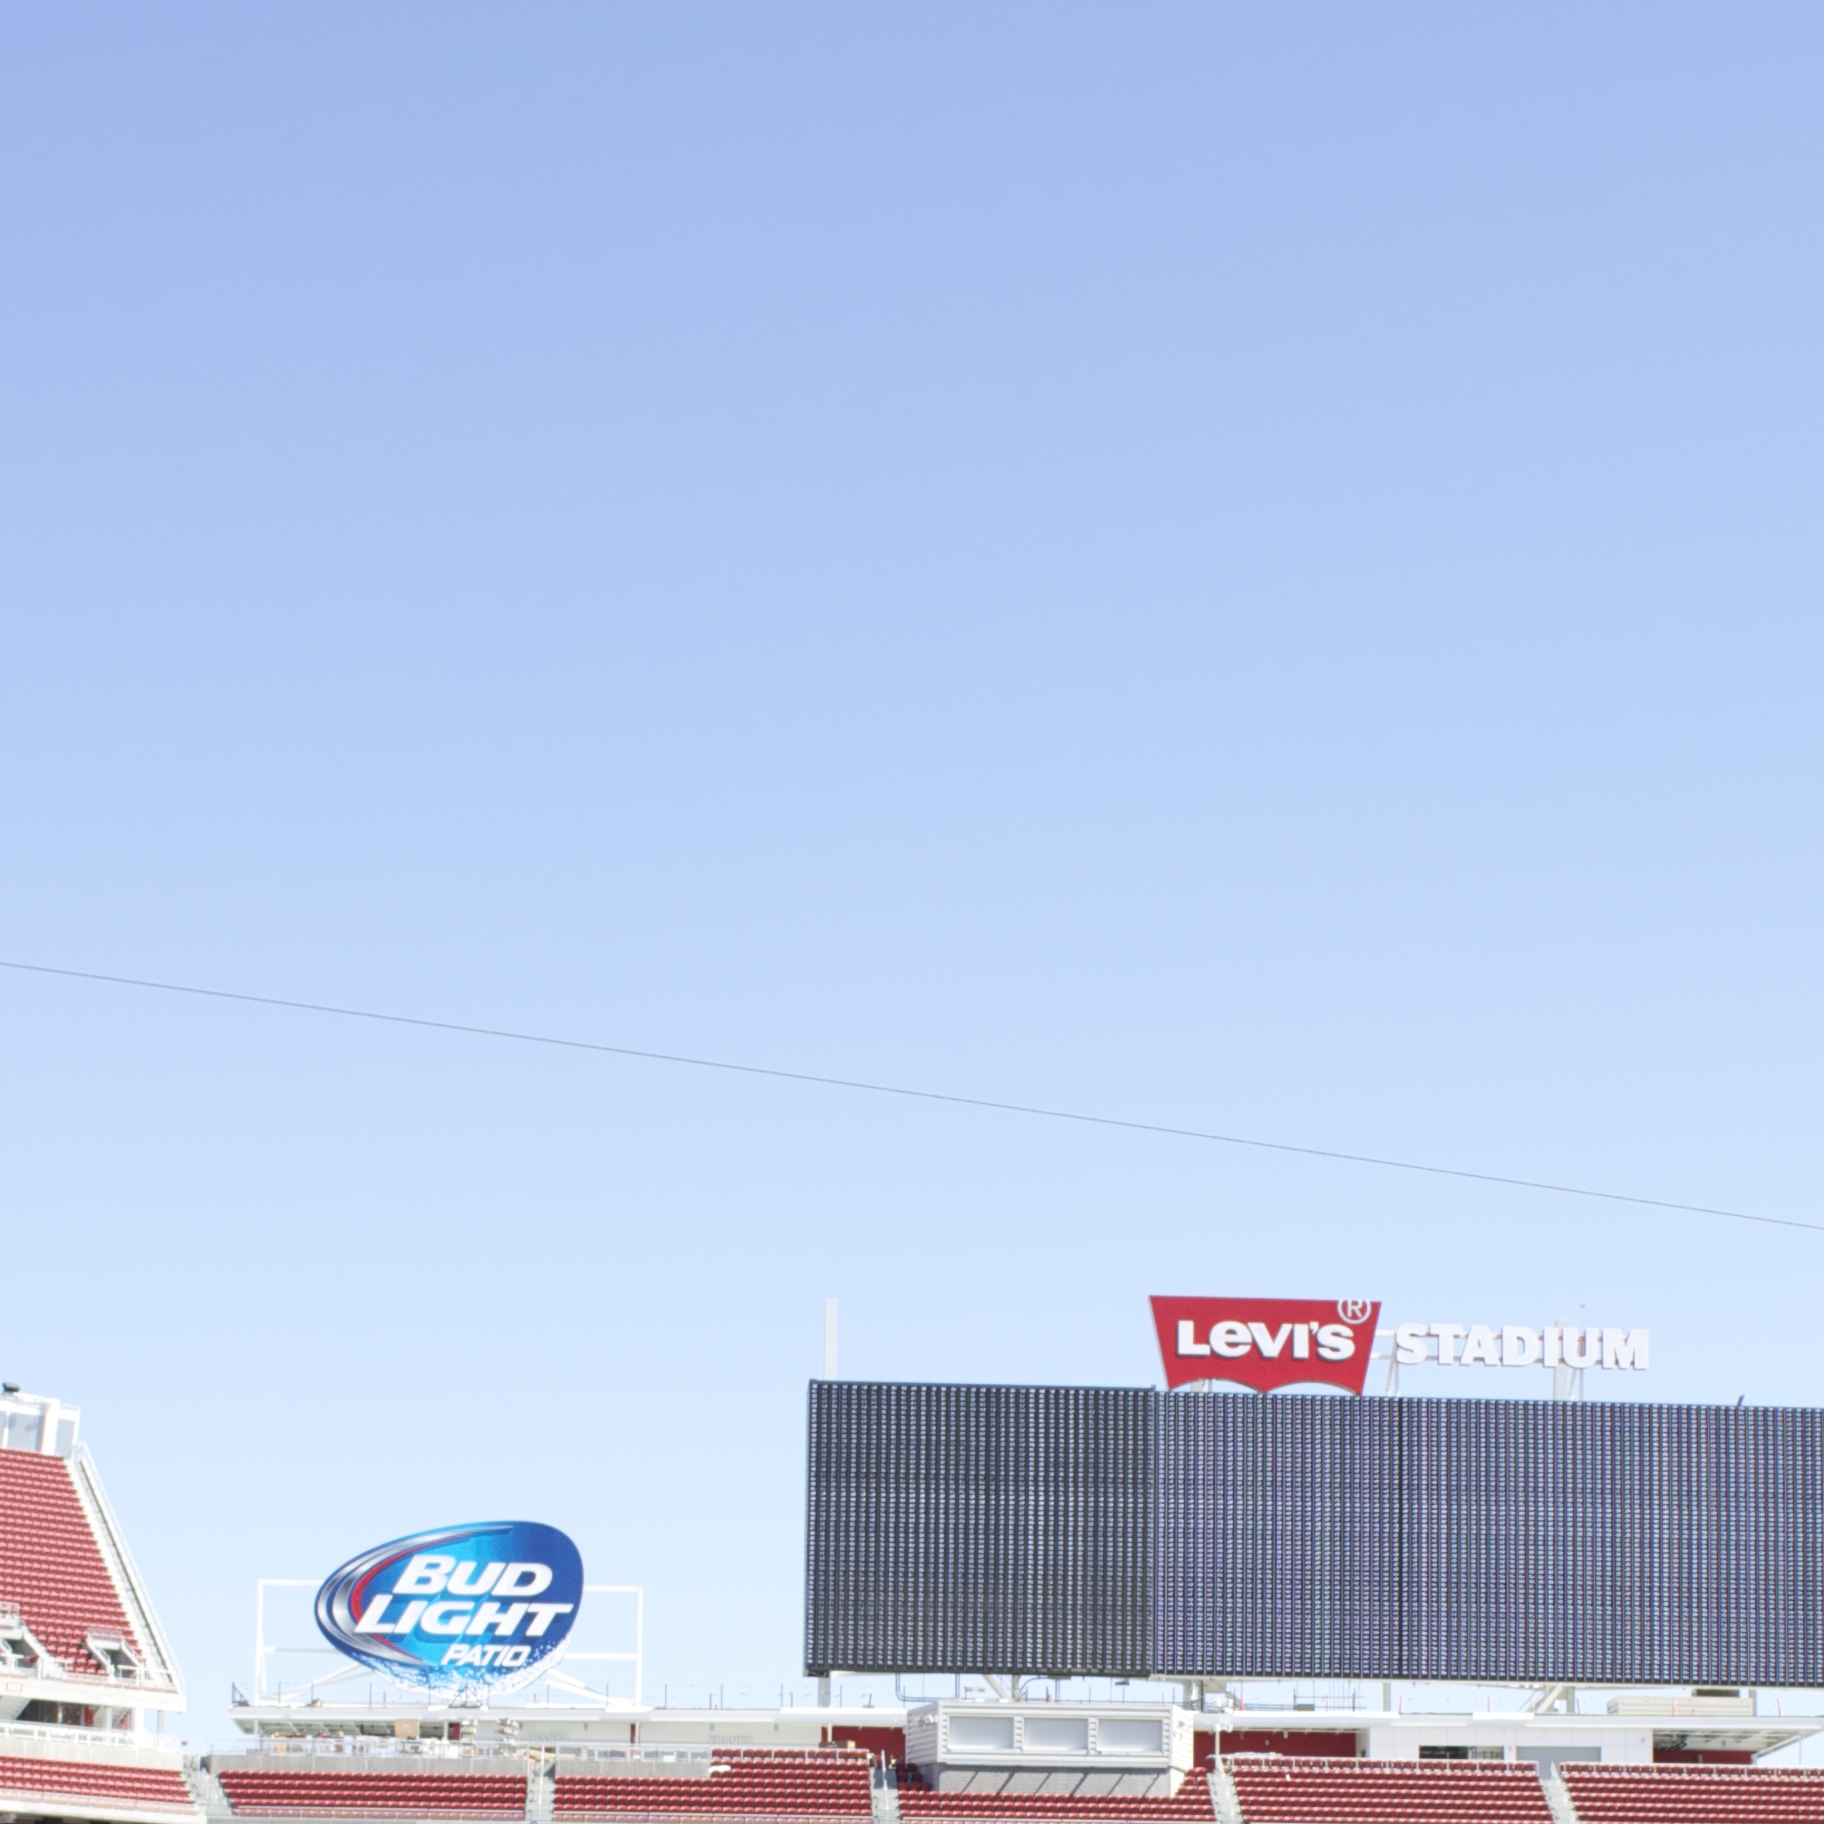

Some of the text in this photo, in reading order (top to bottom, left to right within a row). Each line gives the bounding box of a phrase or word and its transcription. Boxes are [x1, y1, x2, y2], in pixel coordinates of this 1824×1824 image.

[1395, 1323, 1650, 1370] STADIUM
[391, 1554, 554, 1597] BUD
[353, 1593, 575, 1637] LIGHT
[440, 1644, 532, 1668] PATIO
